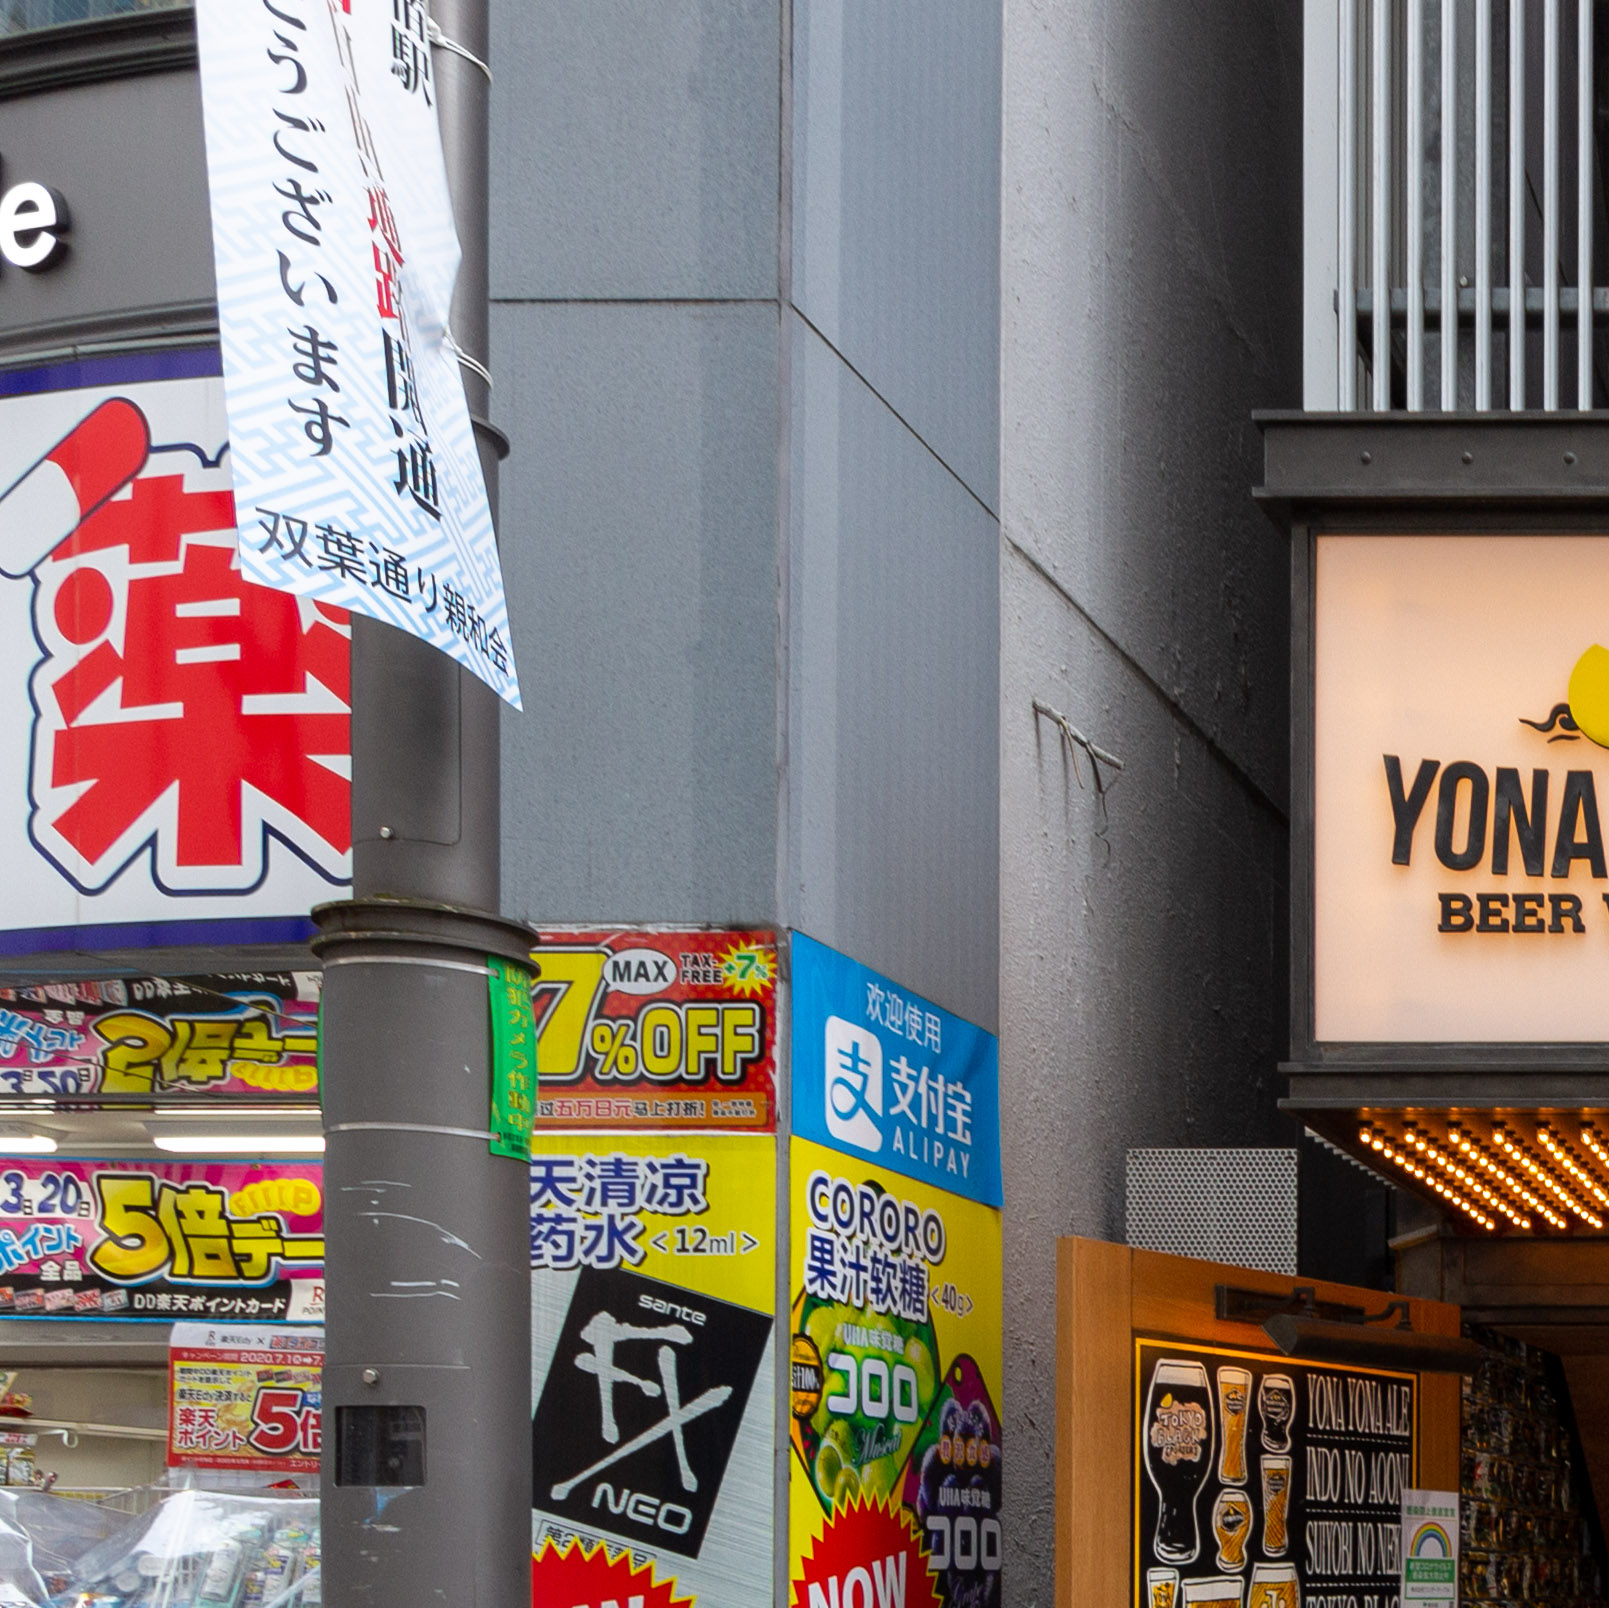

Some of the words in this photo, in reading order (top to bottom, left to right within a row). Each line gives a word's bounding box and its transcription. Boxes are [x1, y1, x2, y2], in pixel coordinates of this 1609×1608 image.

[255, 507, 510, 678] 双葉通り親和会
[1382, 753, 1609, 880] YONA
[1437, 891, 1587, 934] BEER
[612, 960, 669, 983] MAX
[680, 969, 723, 984] FREE
[866, 982, 943, 1054] 欢迎使用
[889, 1057, 972, 1147] 支付宝
[893, 1126, 971, 1179] ALIPAY
[808, 1174, 946, 1264] CORORO
[40, 1260, 83, 1282] 全品
[806, 1235, 928, 1320] 果汁软糖
[638, 1293, 707, 1326] sante
[178, 1407, 217, 1429] 楽天
[1306, 1373, 1345, 1432] YONA
[1347, 1377, 1383, 1434] YONA
[1385, 1383, 1410, 1437] ALE
[177, 1429, 247, 1451] ポイント
[1306, 1446, 1341, 1503] INDO
[1344, 1449, 1366, 1505] NO
[591, 1482, 693, 1535] NEO
[1305, 1521, 1353, 1576] SUIYOBI
[1357, 1521, 1376, 1576] NO
[1377, 1522, 1401, 1576] NEK
